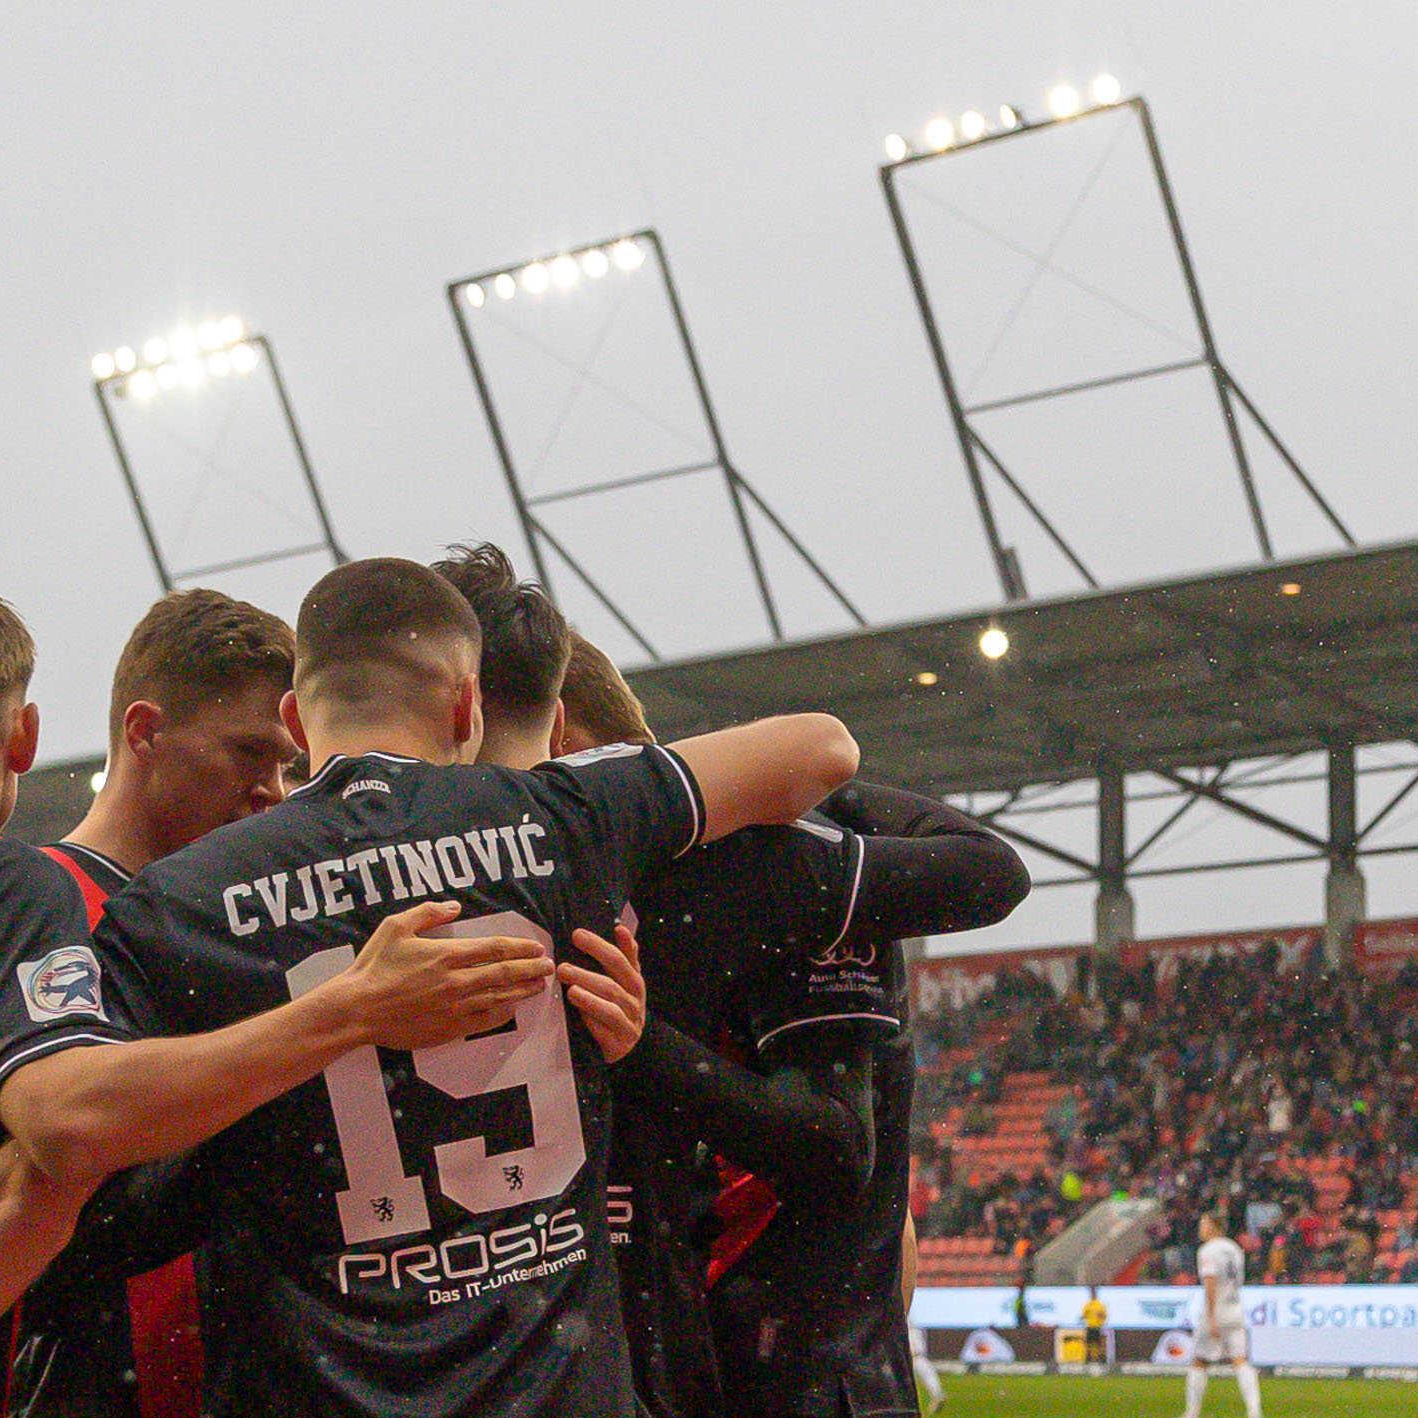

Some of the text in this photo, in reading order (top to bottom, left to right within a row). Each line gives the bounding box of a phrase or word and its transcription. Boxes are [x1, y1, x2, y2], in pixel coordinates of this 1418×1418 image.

[222, 813, 555, 936] CVJETINOVIĆ
[285, 910, 587, 1246] 19
[429, 1287, 461, 1305] Das
